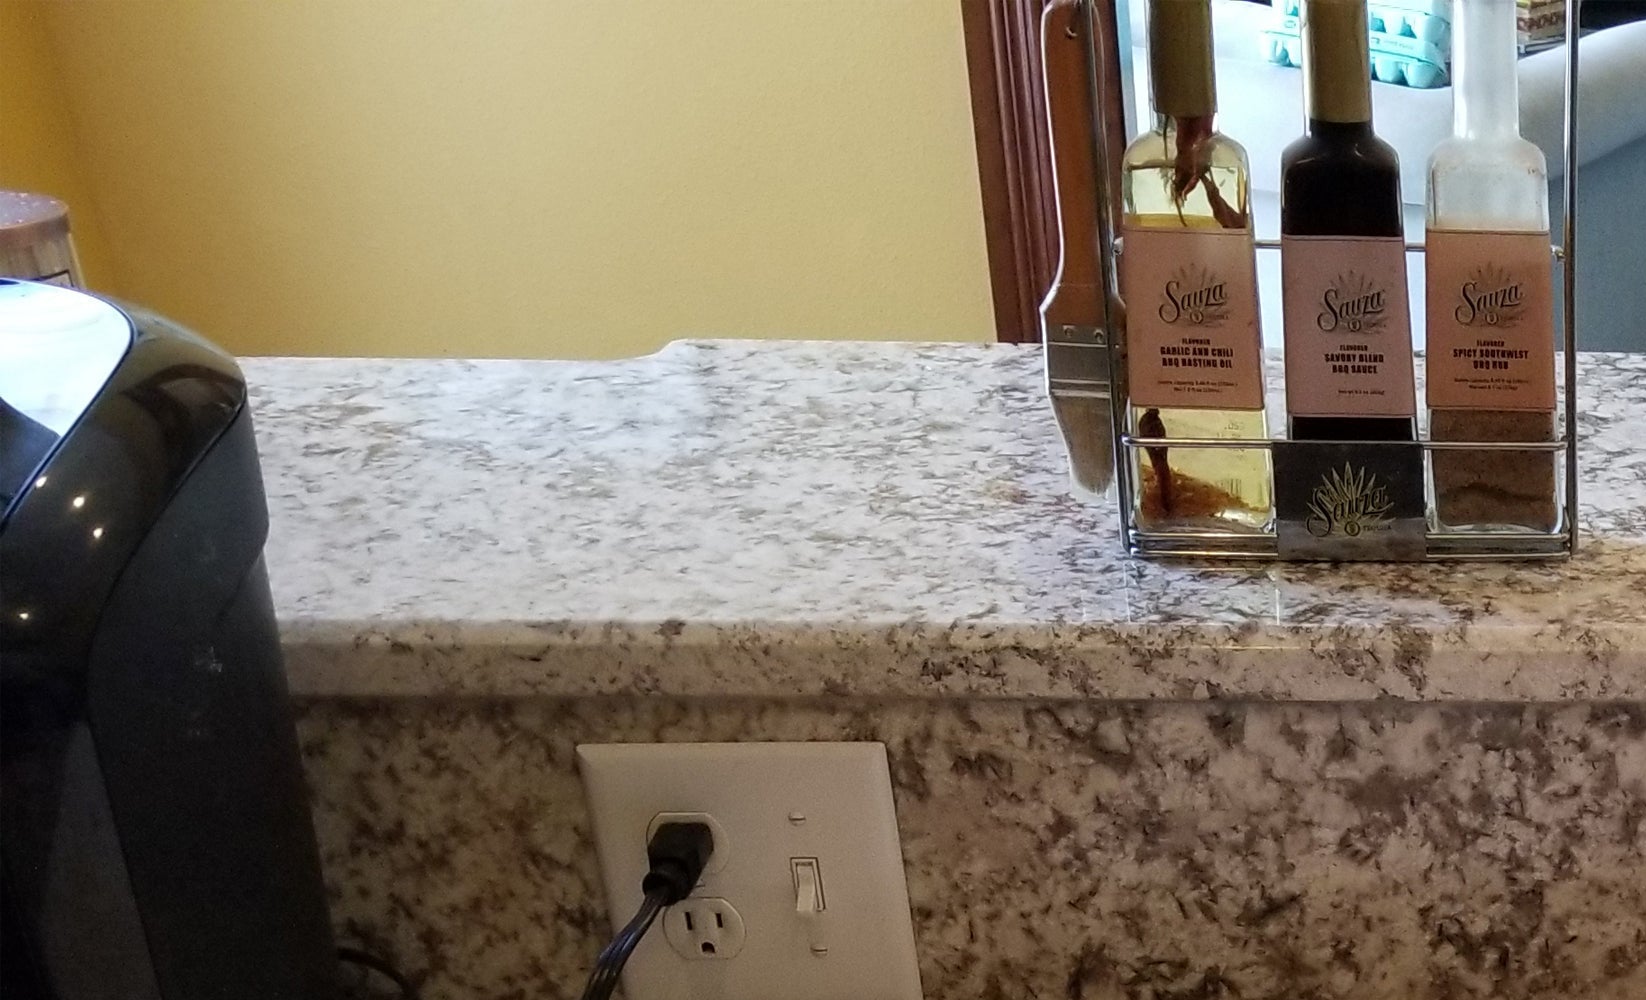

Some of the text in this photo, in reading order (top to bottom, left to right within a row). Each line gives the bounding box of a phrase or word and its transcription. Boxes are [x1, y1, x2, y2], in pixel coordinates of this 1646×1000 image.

[1158, 279, 1227, 324] Sauza
[1317, 288, 1386, 332] Sauza
[1455, 281, 1522, 326] Sauza
[1160, 346, 1190, 356] GARLIC
[1192, 347, 1209, 357] AND
[1453, 348, 1528, 359] SPICY SOUTHWEST
[1306, 486, 1394, 538] Sauza
